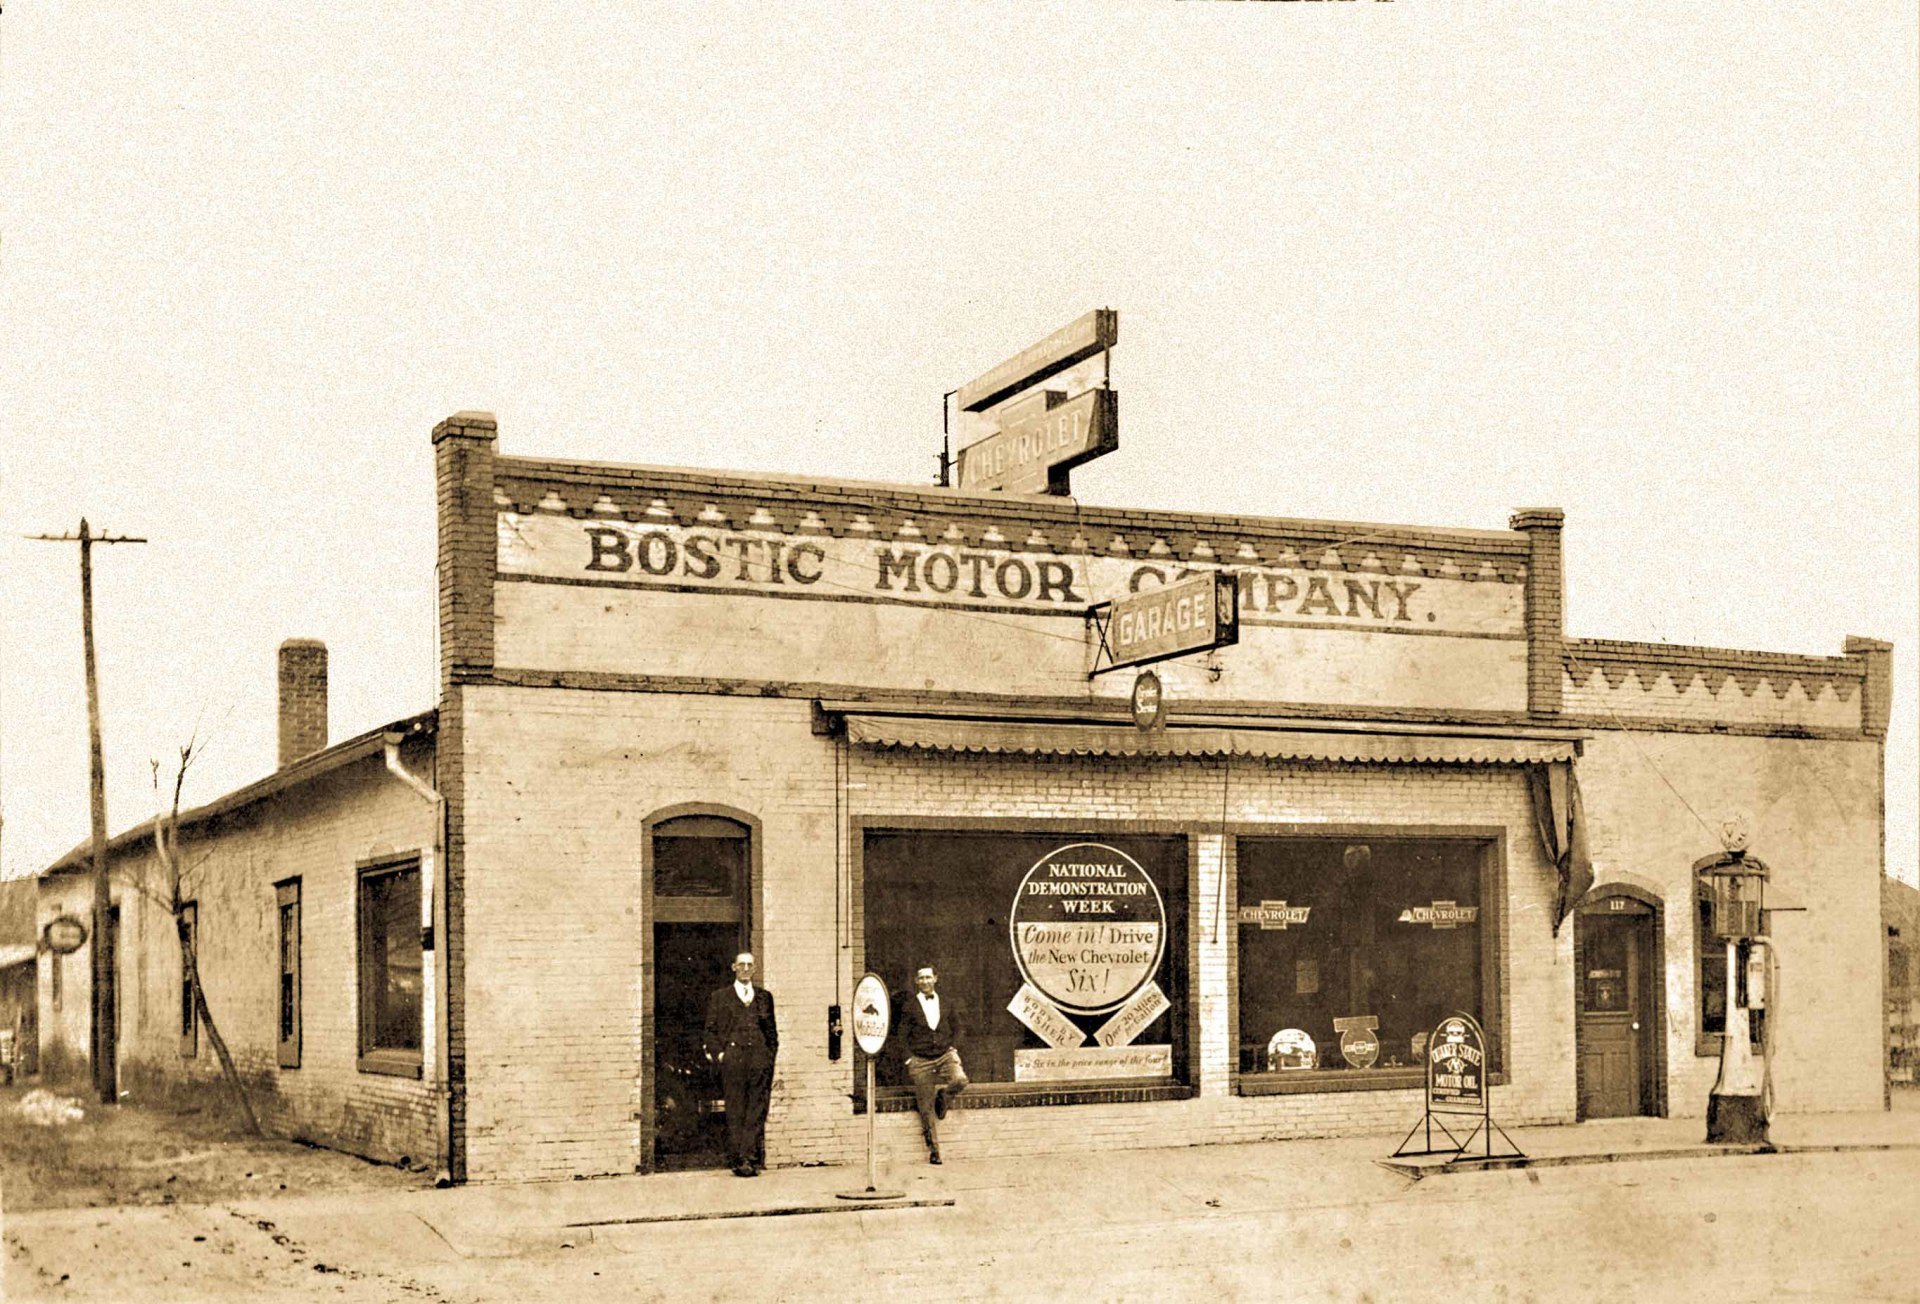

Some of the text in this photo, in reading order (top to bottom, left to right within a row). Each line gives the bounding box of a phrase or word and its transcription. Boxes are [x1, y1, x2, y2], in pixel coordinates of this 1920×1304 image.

[970, 410, 1082, 484] CHEVROLET
[584, 527, 1436, 622] BOSTIC MOTOR CPANY.
[1120, 592, 1206, 646] GARAGE
[1048, 864, 1127, 878] NATIONAL
[1028, 881, 1148, 896] DEMONSTRATION
[1061, 899, 1116, 914] WEEK
[1243, 909, 1304, 921] CHEVROLET
[1415, 909, 1473, 921] CHEVROLET
[1610, 901, 1625, 911] 117
[1024, 924, 1154, 944] Come in! Drive
[1028, 949, 1149, 964] the New Chevrolet
[1065, 968, 1110, 994] Six!
[1024, 995, 1075, 1041] BODY BY
[1105, 993, 1158, 1047] Over 20 Miles
[1133, 998, 1162, 1025] Gallon
[1023, 1006, 1066, 1046] FISHER
[1458, 1044, 1481, 1066] STATE
[1435, 1073, 1478, 1089] MOTOR OIL
